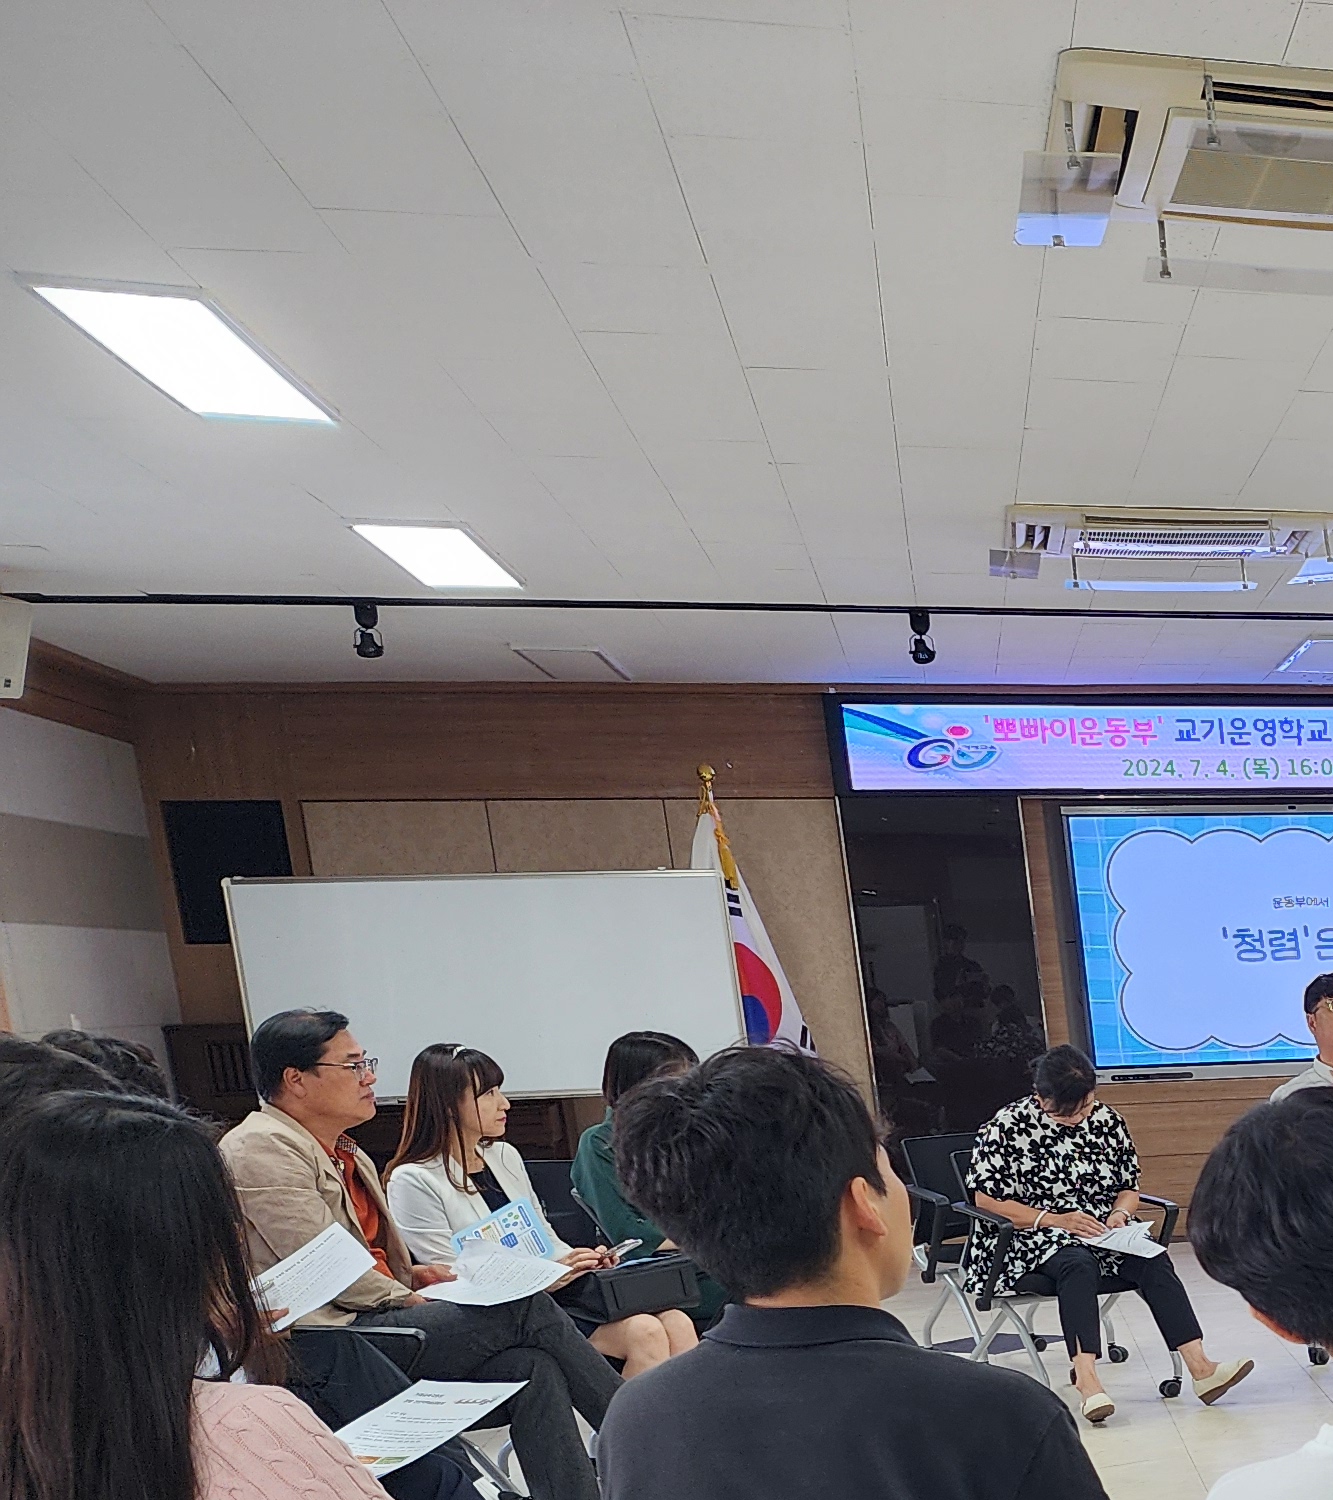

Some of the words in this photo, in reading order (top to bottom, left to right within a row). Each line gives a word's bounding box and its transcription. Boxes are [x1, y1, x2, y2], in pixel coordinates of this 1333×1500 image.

[1174, 717, 1332, 747] 교기운영학교
[1122, 758, 1184, 779] 2024.
[1243, 757, 1280, 781] (목)
[1272, 895, 1330, 909] 운동부에서
